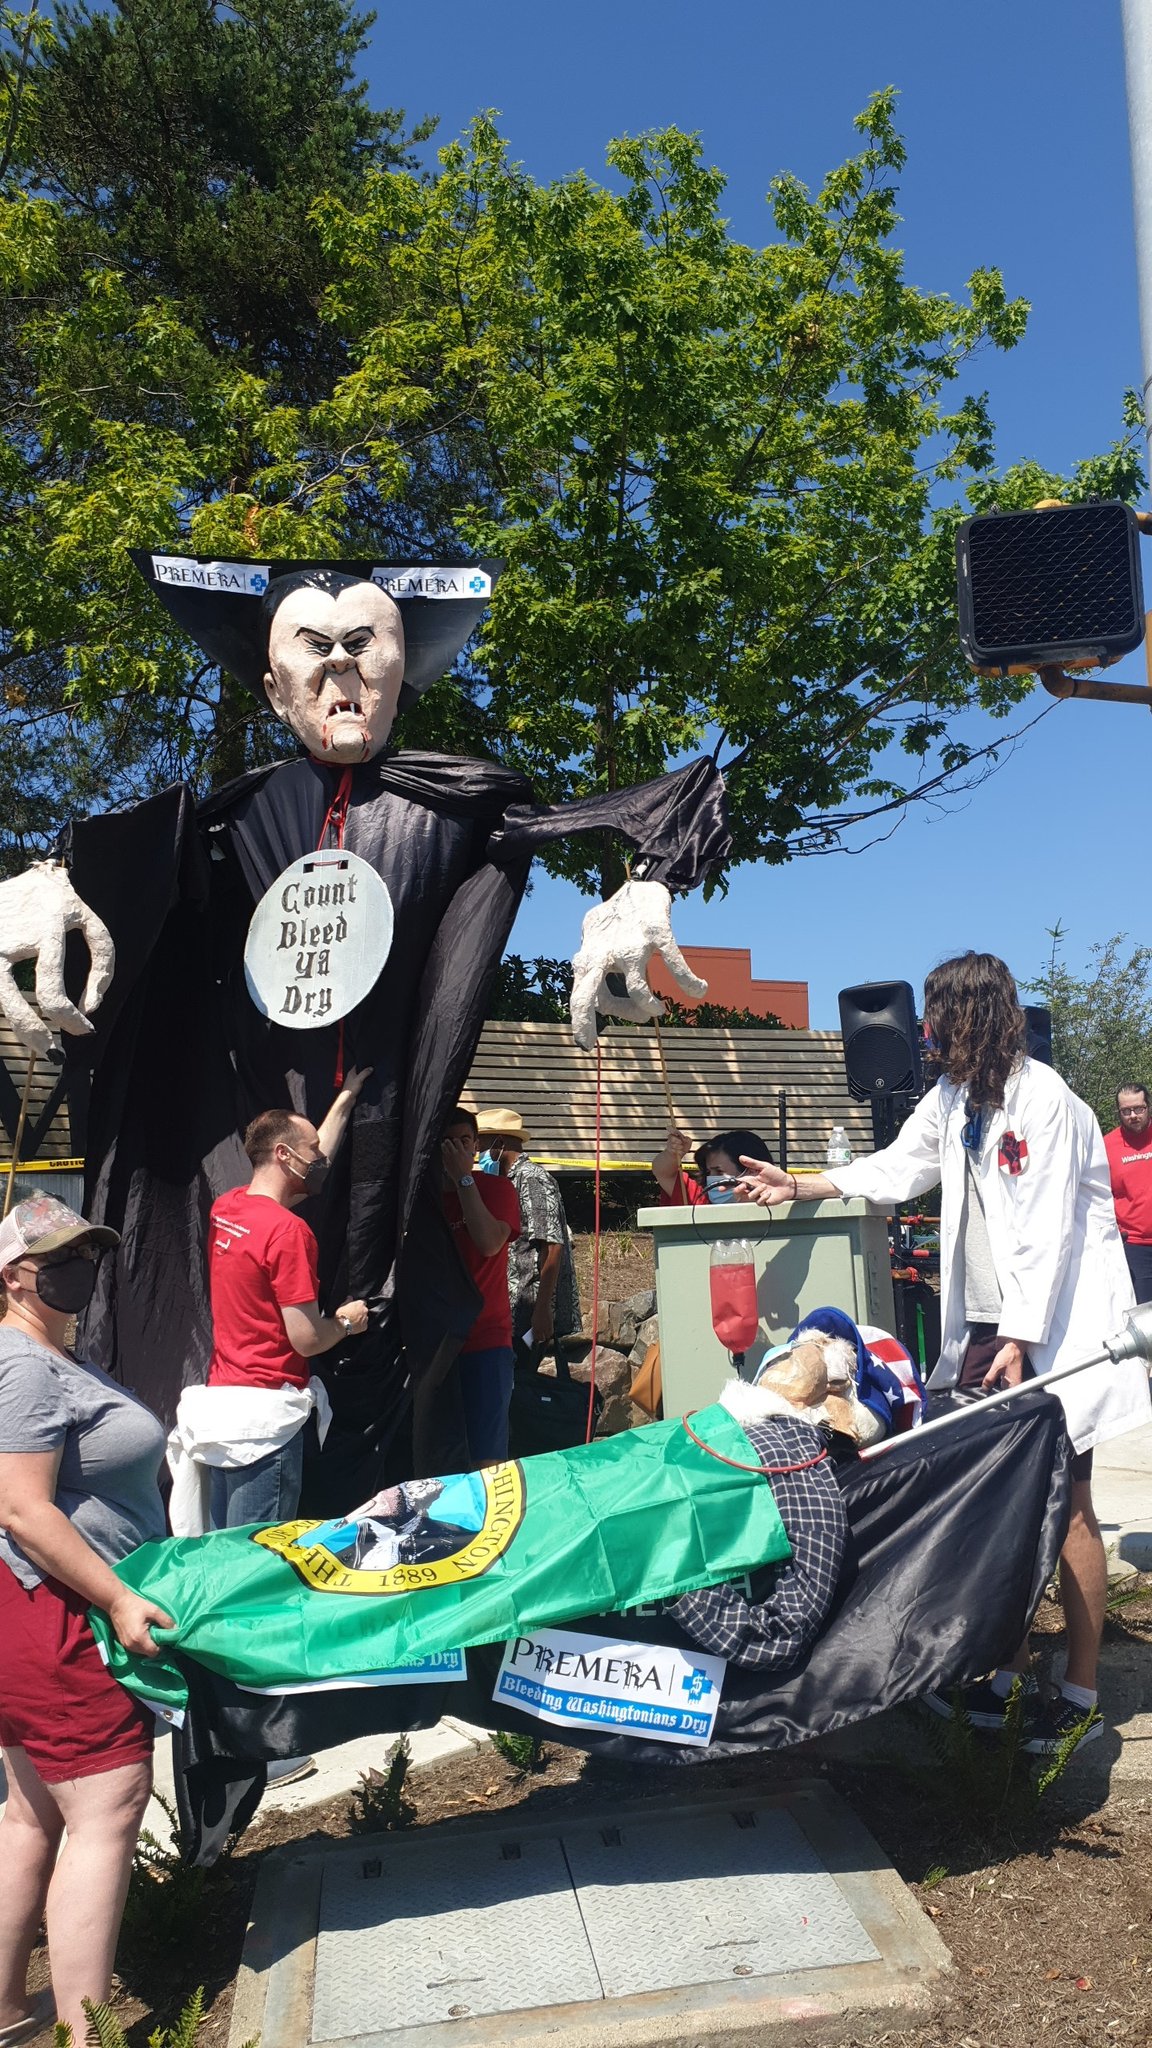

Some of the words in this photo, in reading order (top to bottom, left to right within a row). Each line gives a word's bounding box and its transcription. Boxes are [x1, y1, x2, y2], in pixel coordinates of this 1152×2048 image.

[156, 564, 240, 588] PREMERA
[281, 874, 358, 914] Count
[277, 911, 348, 951] Bleed
[279, 985, 332, 1018] Dry
[453, 1461, 513, 1574] SHINGTON
[378, 1568, 437, 1587] 1889
[430, 1651, 458, 1668] Dry
[510, 1637, 662, 1692] PREMERA
[502, 1674, 563, 1711] Bleeding
[566, 1696, 677, 1728] Washingtonians
[679, 1714, 707, 1735] Dry
